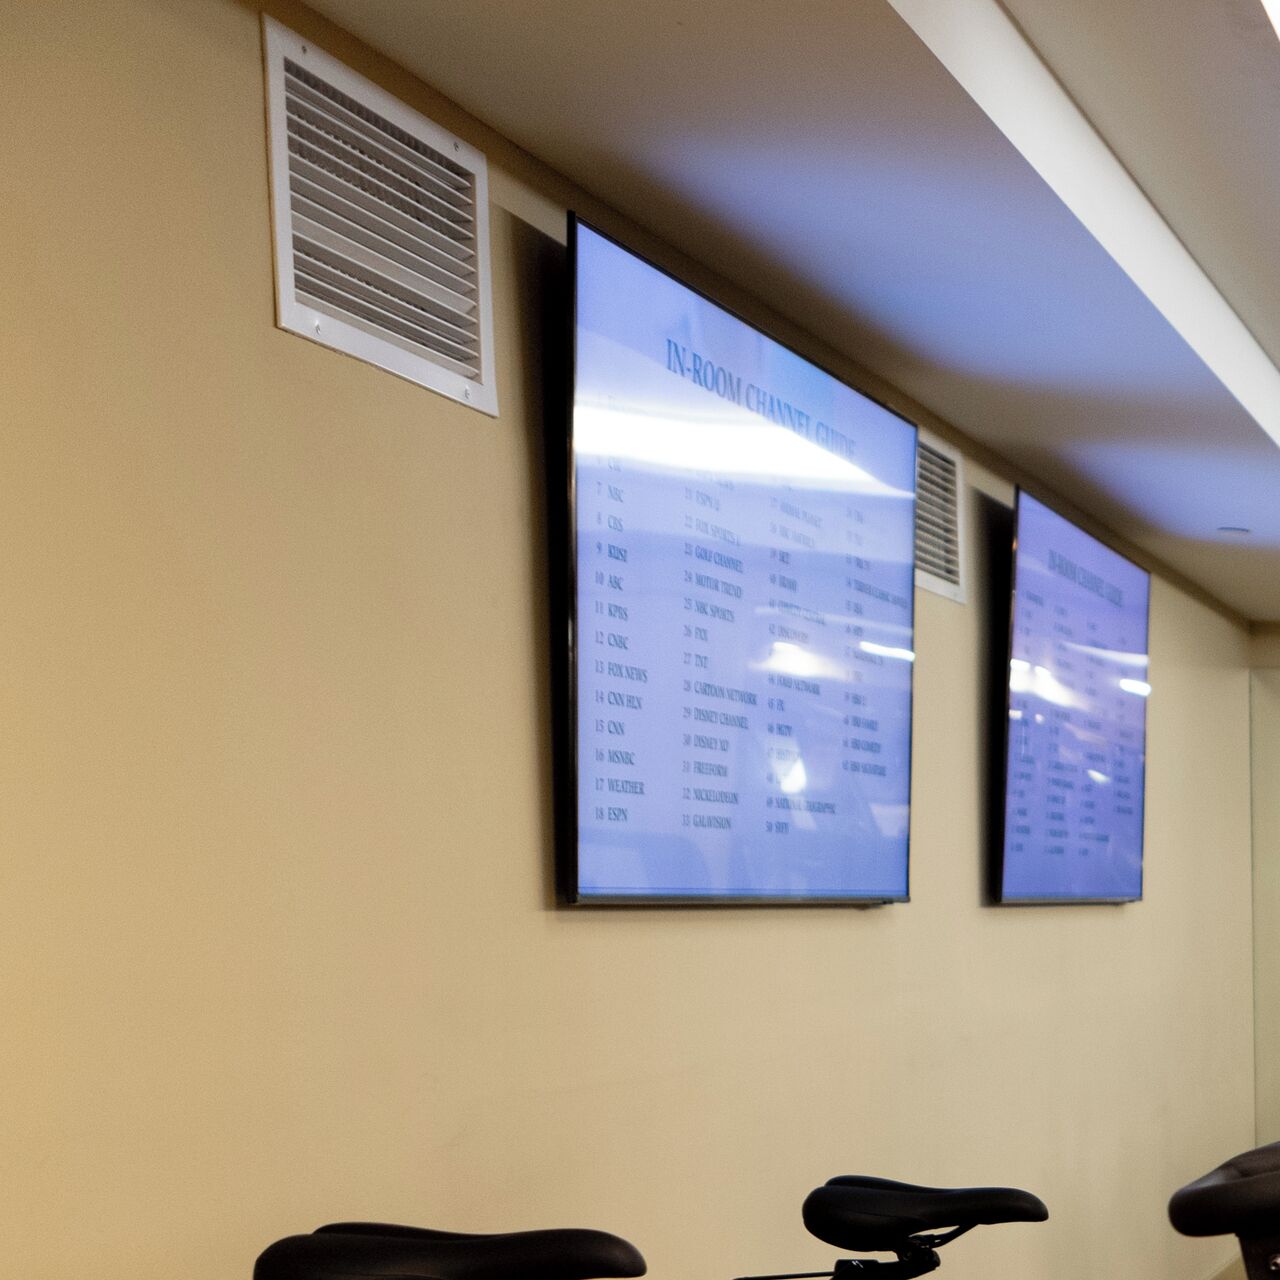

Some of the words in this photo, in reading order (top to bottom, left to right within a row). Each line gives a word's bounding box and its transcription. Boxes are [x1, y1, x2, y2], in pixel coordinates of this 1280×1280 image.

[666, 338, 741, 406] IN-ROOM
[744, 383, 810, 442] CHANNEL
[815, 421, 857, 458] GUIDE
[695, 545, 712, 562] GOLF
[714, 552, 743, 573] CHANNEL
[608, 661, 623, 679] FOX
[625, 664, 648, 684] NEWS
[608, 691, 624, 707] CNN
[694, 681, 725, 699] CARTOON
[726, 687, 757, 706] NETWORK
[694, 707, 719, 724] DISNEY
[720, 712, 749, 730] CHANNEL
[608, 720, 624, 736] CNN
[694, 734, 718, 751] DISNEY
[608, 749, 635, 766] MSNBC
[608, 778, 645, 796] WEATHER
[608, 807, 628, 822] ESPN
